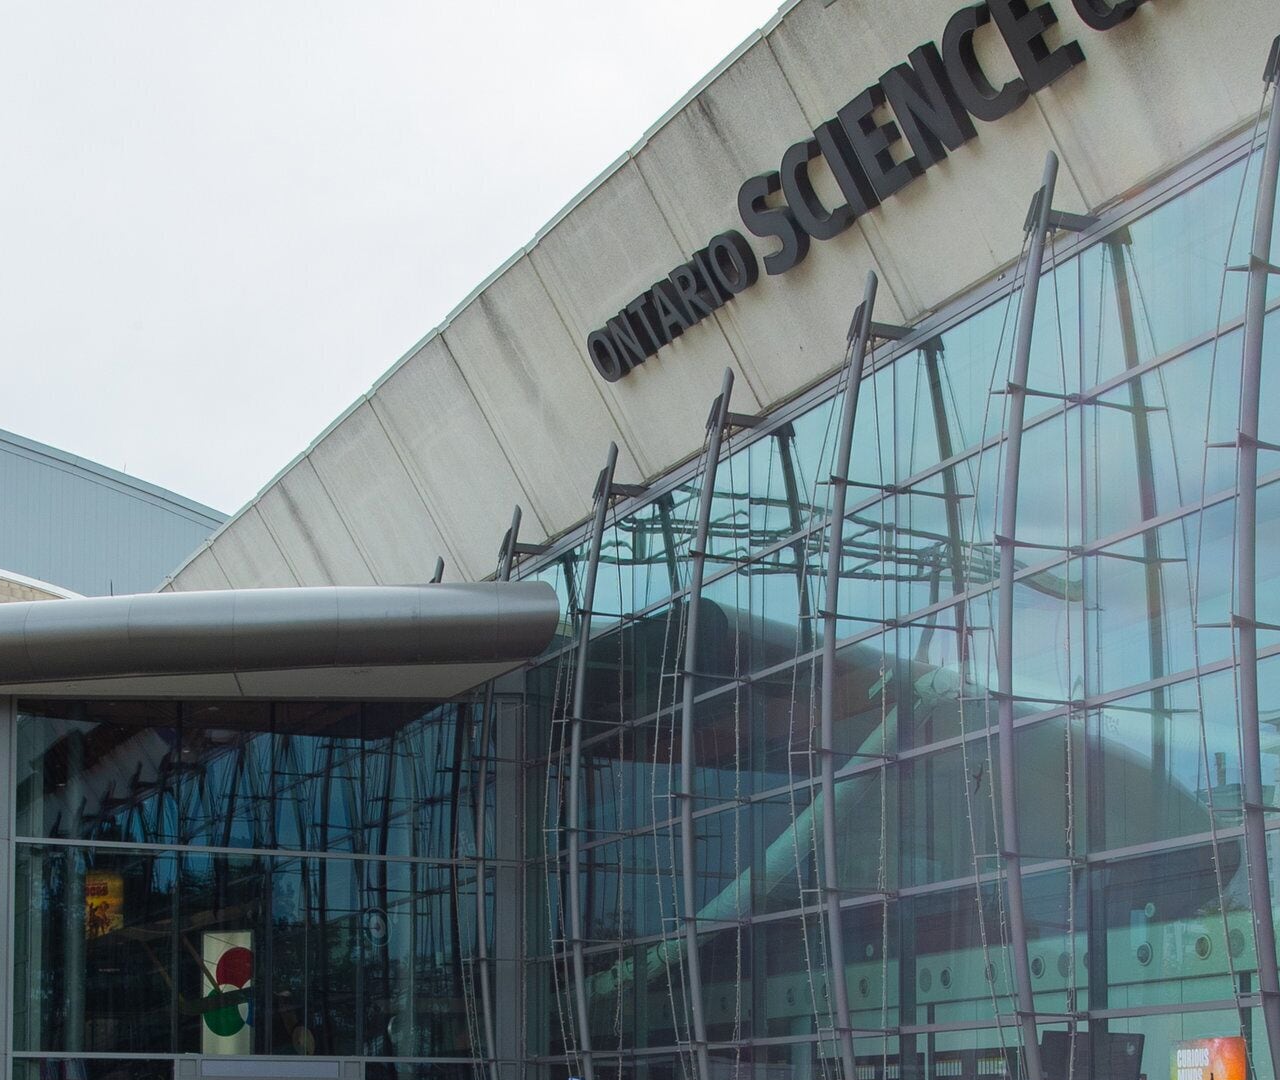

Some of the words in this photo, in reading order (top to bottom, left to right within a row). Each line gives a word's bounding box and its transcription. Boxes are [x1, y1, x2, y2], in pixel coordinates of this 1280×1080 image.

[587, 229, 759, 383] ONTARIO
[737, 0, 1087, 276] SCIENCE
[1177, 1048, 1209, 1068] CURIOUS
